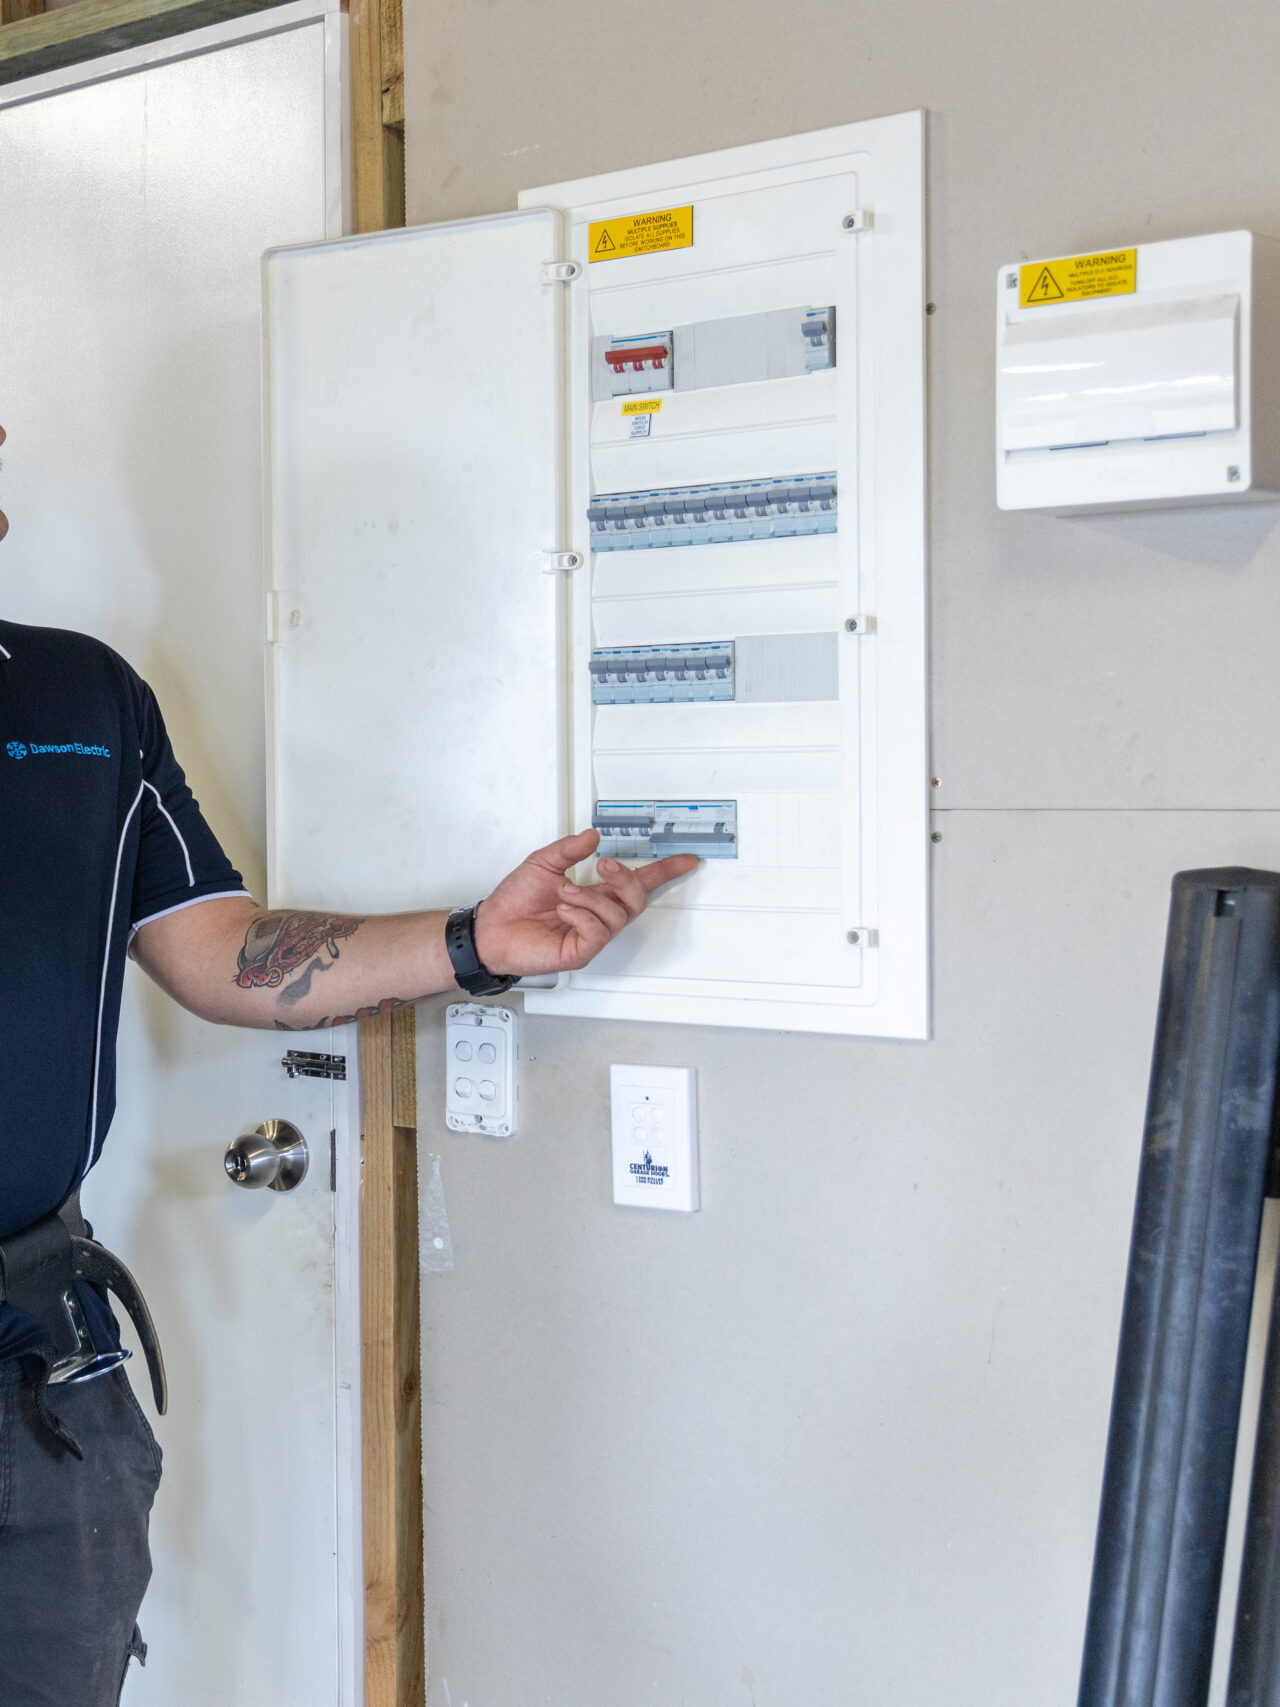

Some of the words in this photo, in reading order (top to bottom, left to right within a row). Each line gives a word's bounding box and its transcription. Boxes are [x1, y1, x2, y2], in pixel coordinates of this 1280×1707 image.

[633, 213, 672, 227] WARNING
[624, 233, 645, 241] ISOLATE
[655, 227, 680, 237] SUPPLIES
[627, 225, 651, 235] MULTIPLE
[653, 221, 678, 231] SUPPLIES
[619, 241, 640, 249] BEFORE
[640, 237, 664, 245] WORKING
[674, 232, 686, 240] THIS
[634, 242, 671, 252] SWITCHBOARD
[1074, 253, 1126, 269] WARNING
[623, 403, 638, 412] MAIN
[638, 401, 661, 411] SWITCH
[30, 742, 74, 754] Dawson
[74, 743, 111, 758] Electric
[630, 1163, 668, 1172] CENTURION
